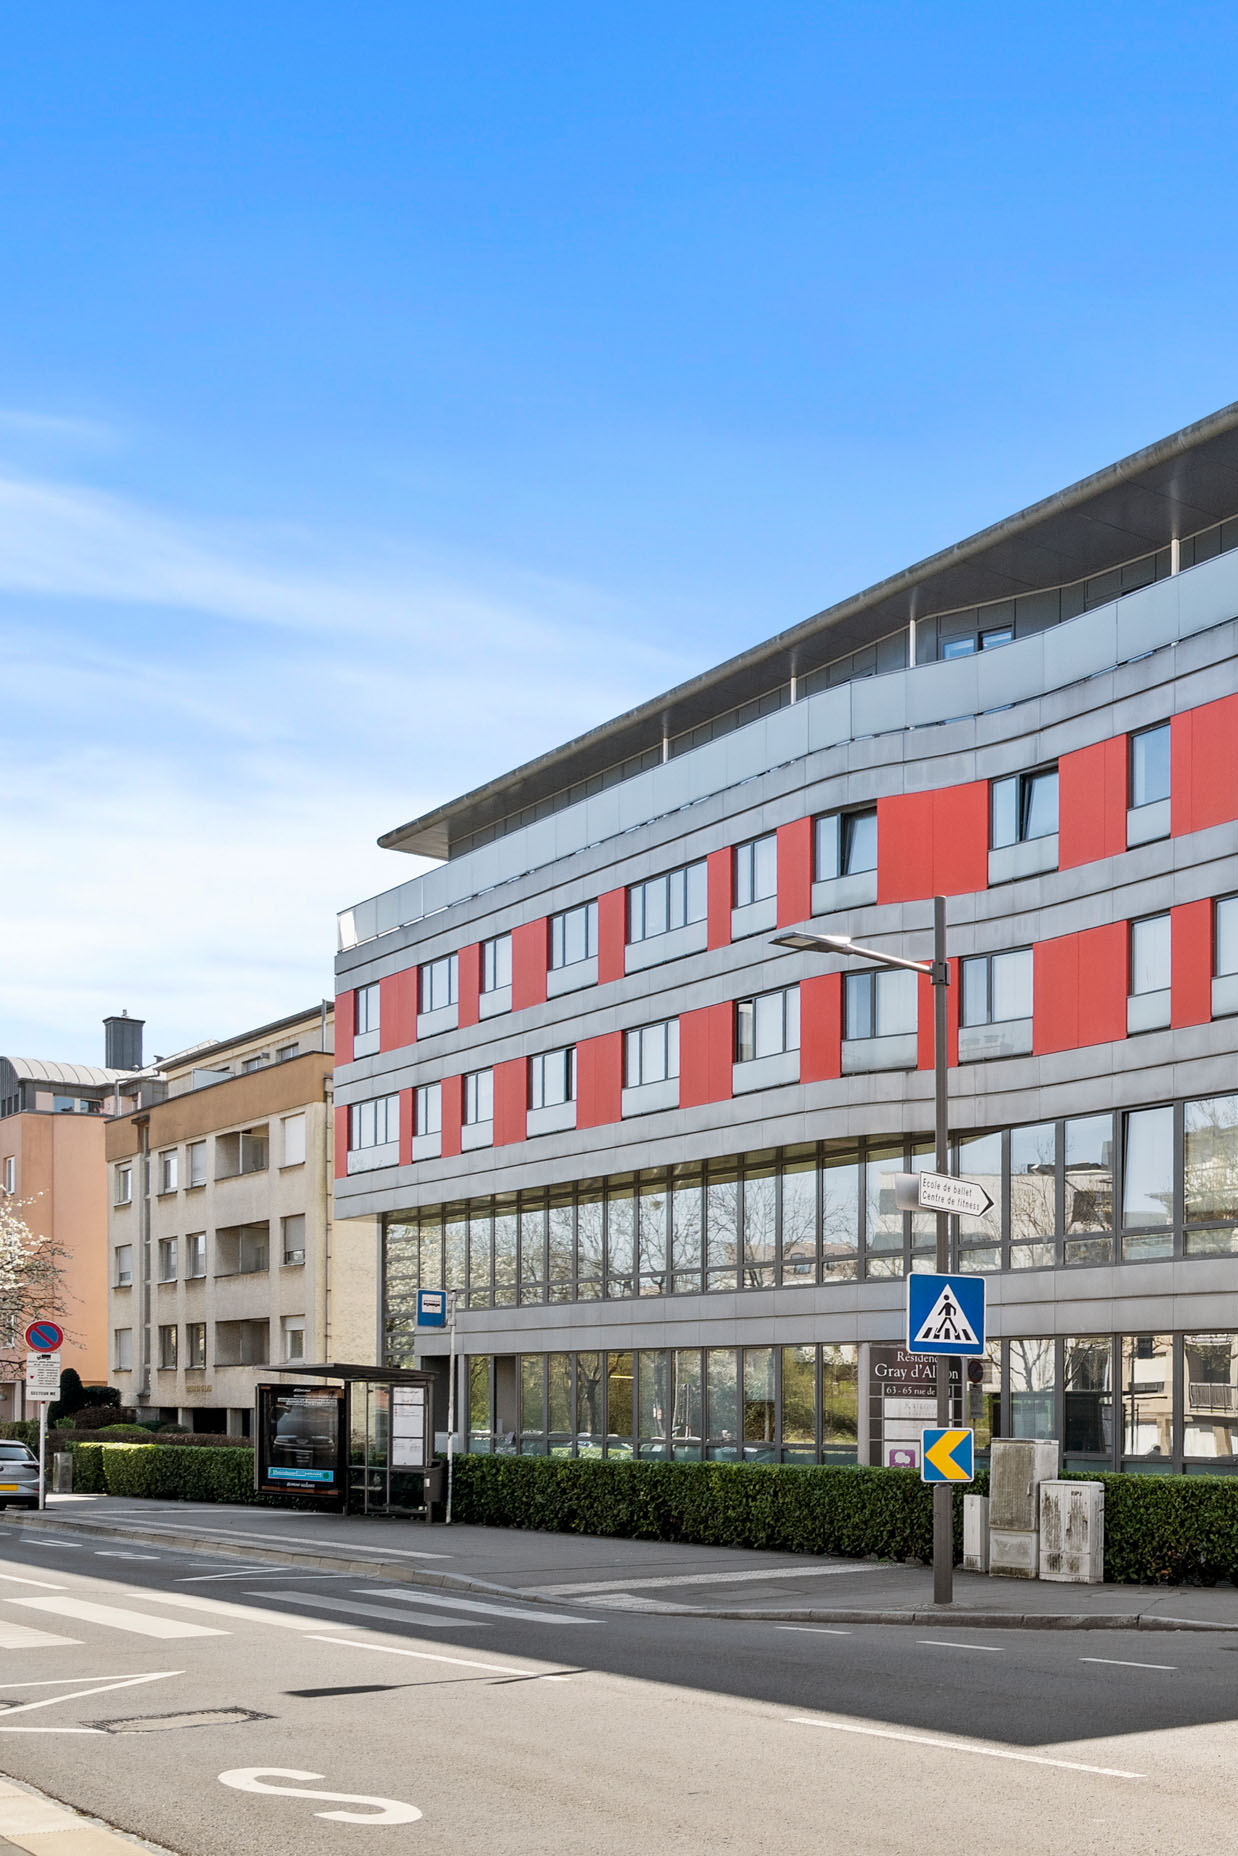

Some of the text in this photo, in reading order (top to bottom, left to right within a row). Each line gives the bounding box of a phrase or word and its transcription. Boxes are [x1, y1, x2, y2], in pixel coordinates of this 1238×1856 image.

[923, 1178, 972, 1197] Ecole de ballet
[922, 1190, 980, 1211] Centre de fitness
[897, 1351, 938, 1363] Résidenc
[874, 1363, 907, 1380] Gray
[886, 1386, 896, 1395] 63
[902, 1386, 912, 1395] 65
[914, 1388, 926, 1396] rue
[926, 1387, 936, 1396] de
[217, 1767, 423, 1824] S
